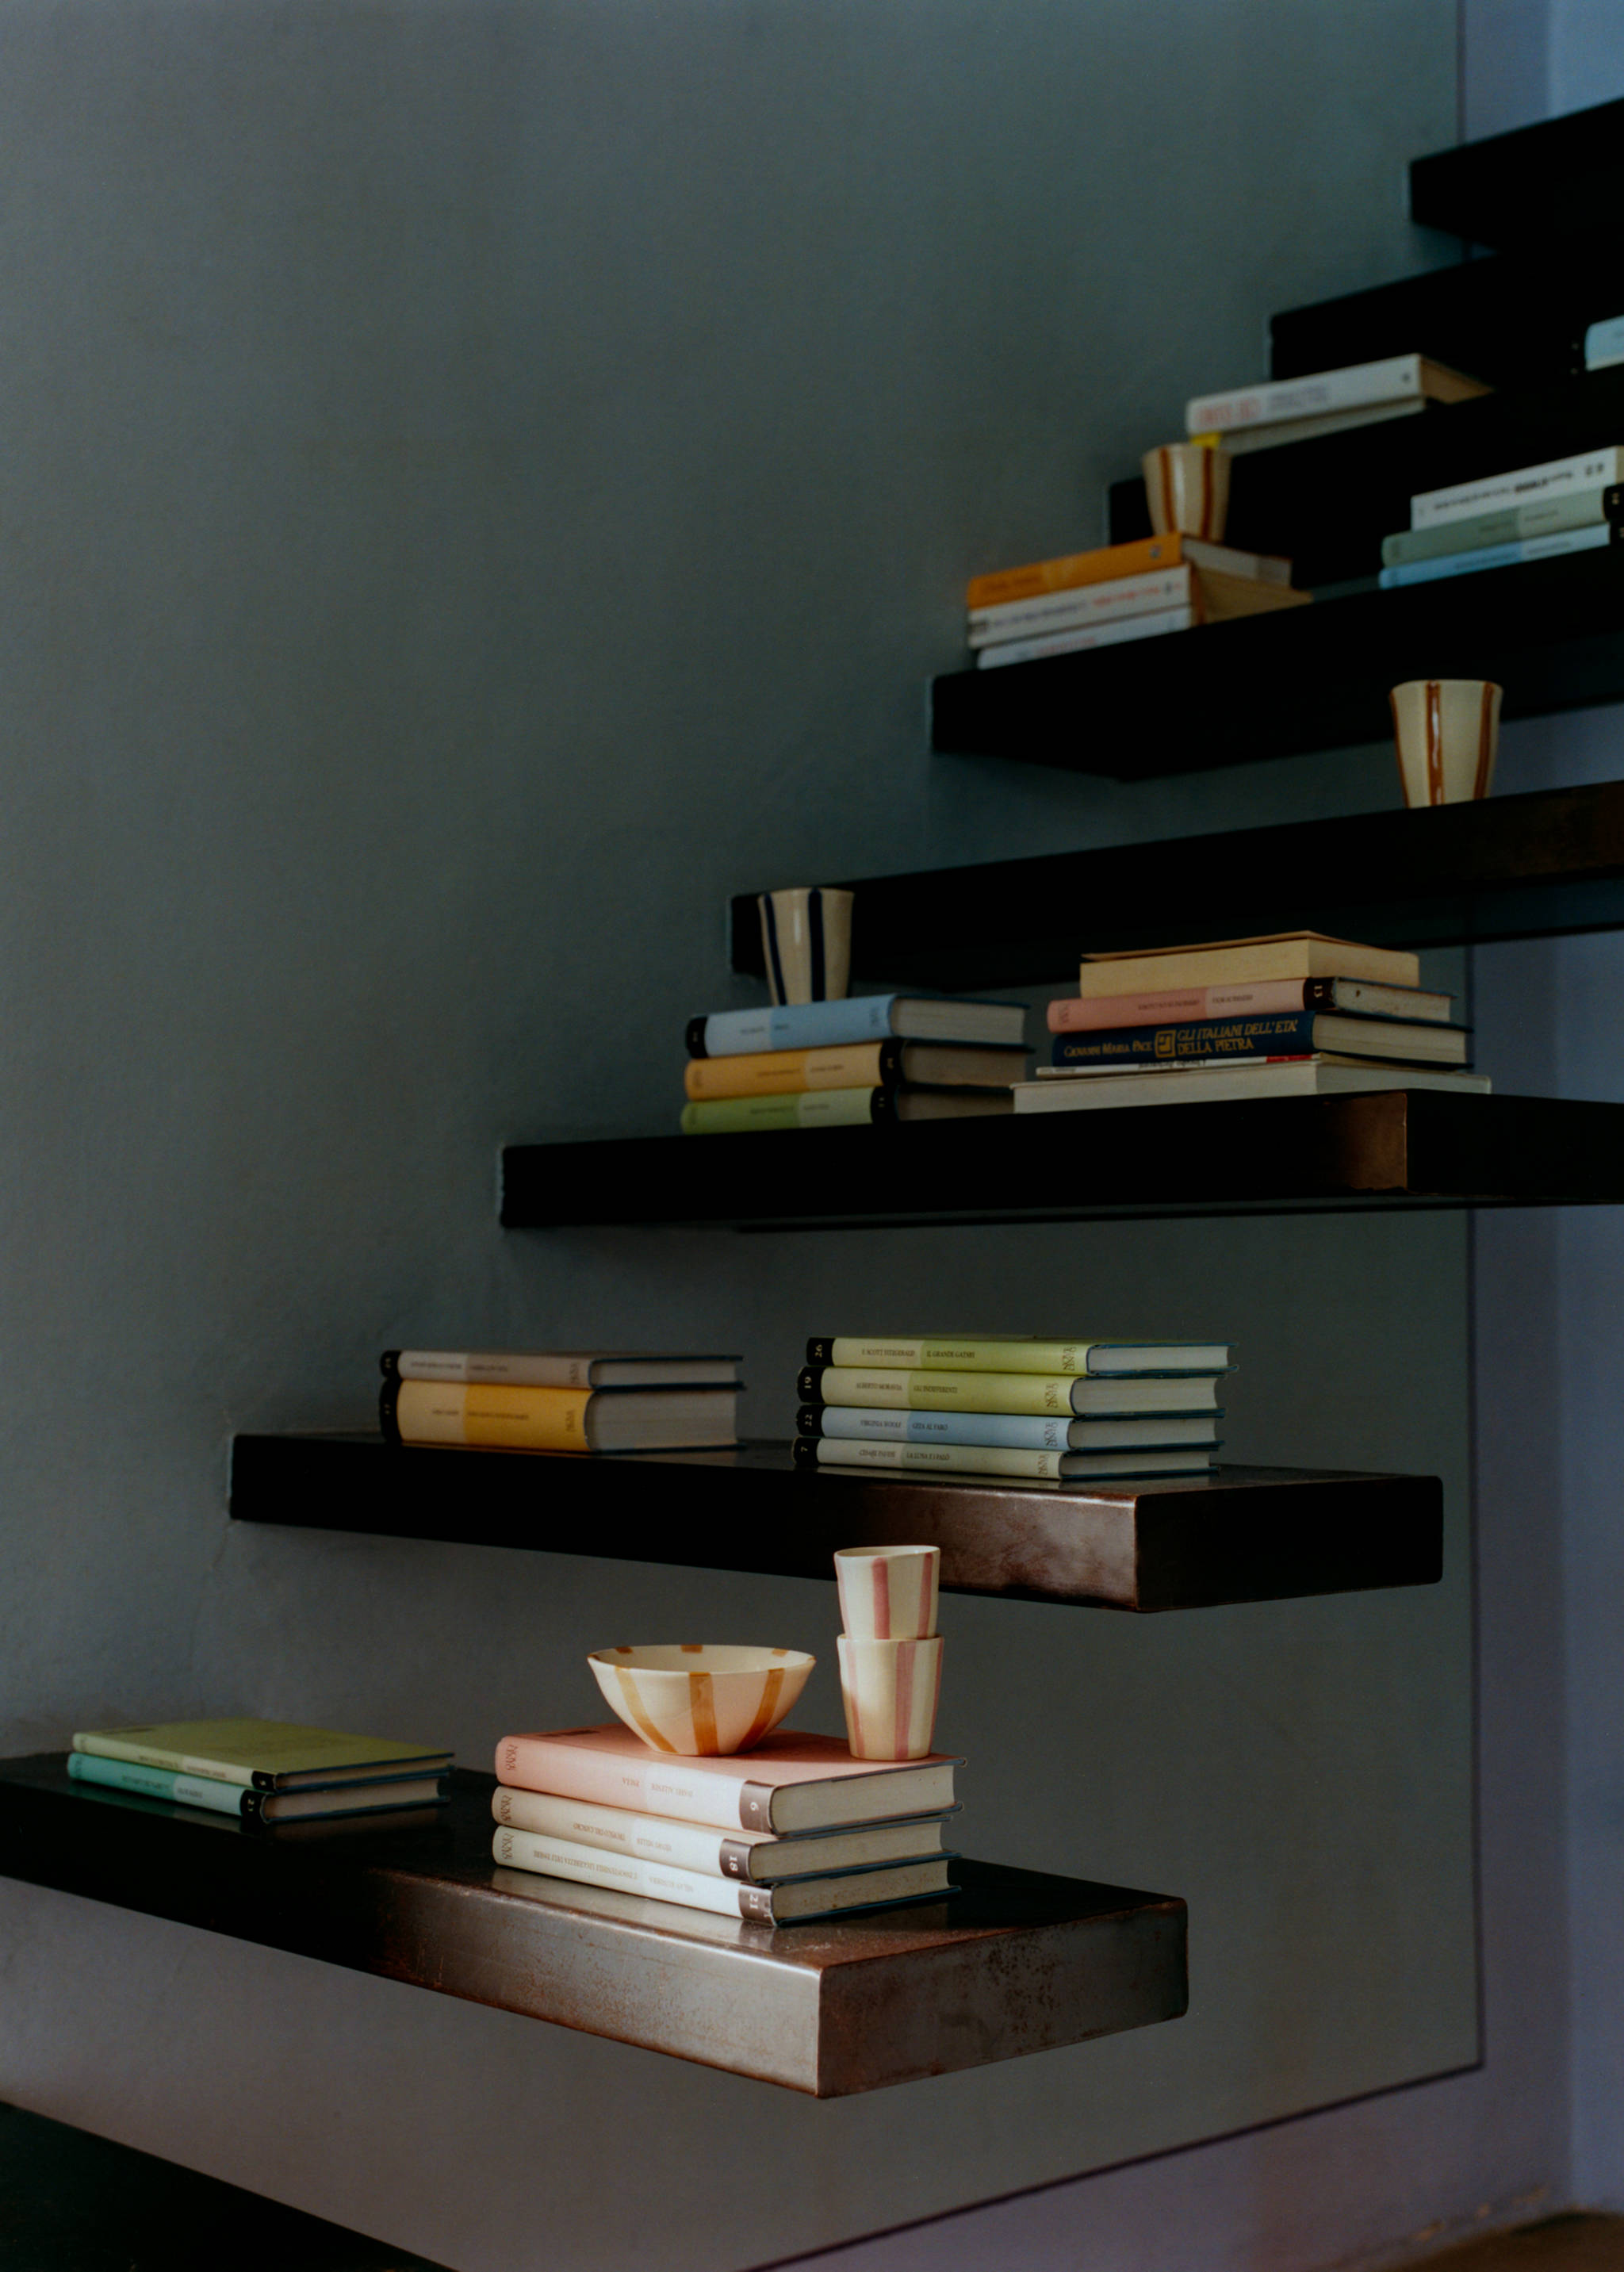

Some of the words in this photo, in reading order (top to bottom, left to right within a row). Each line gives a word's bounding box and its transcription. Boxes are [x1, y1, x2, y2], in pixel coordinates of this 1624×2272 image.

[1178, 1028, 1196, 1042] GLI
[1197, 1024, 1243, 1040] ITALIANI
[1102, 1041, 1131, 1055] MARIA
[1178, 1040, 1213, 1056] DELLA
[1215, 1037, 1254, 1052] PIETRA
[804, 1376, 812, 1389] 19
[750, 1801, 758, 1811] 6
[730, 1856, 738, 1872] 18
[749, 1895, 758, 1910] 21
